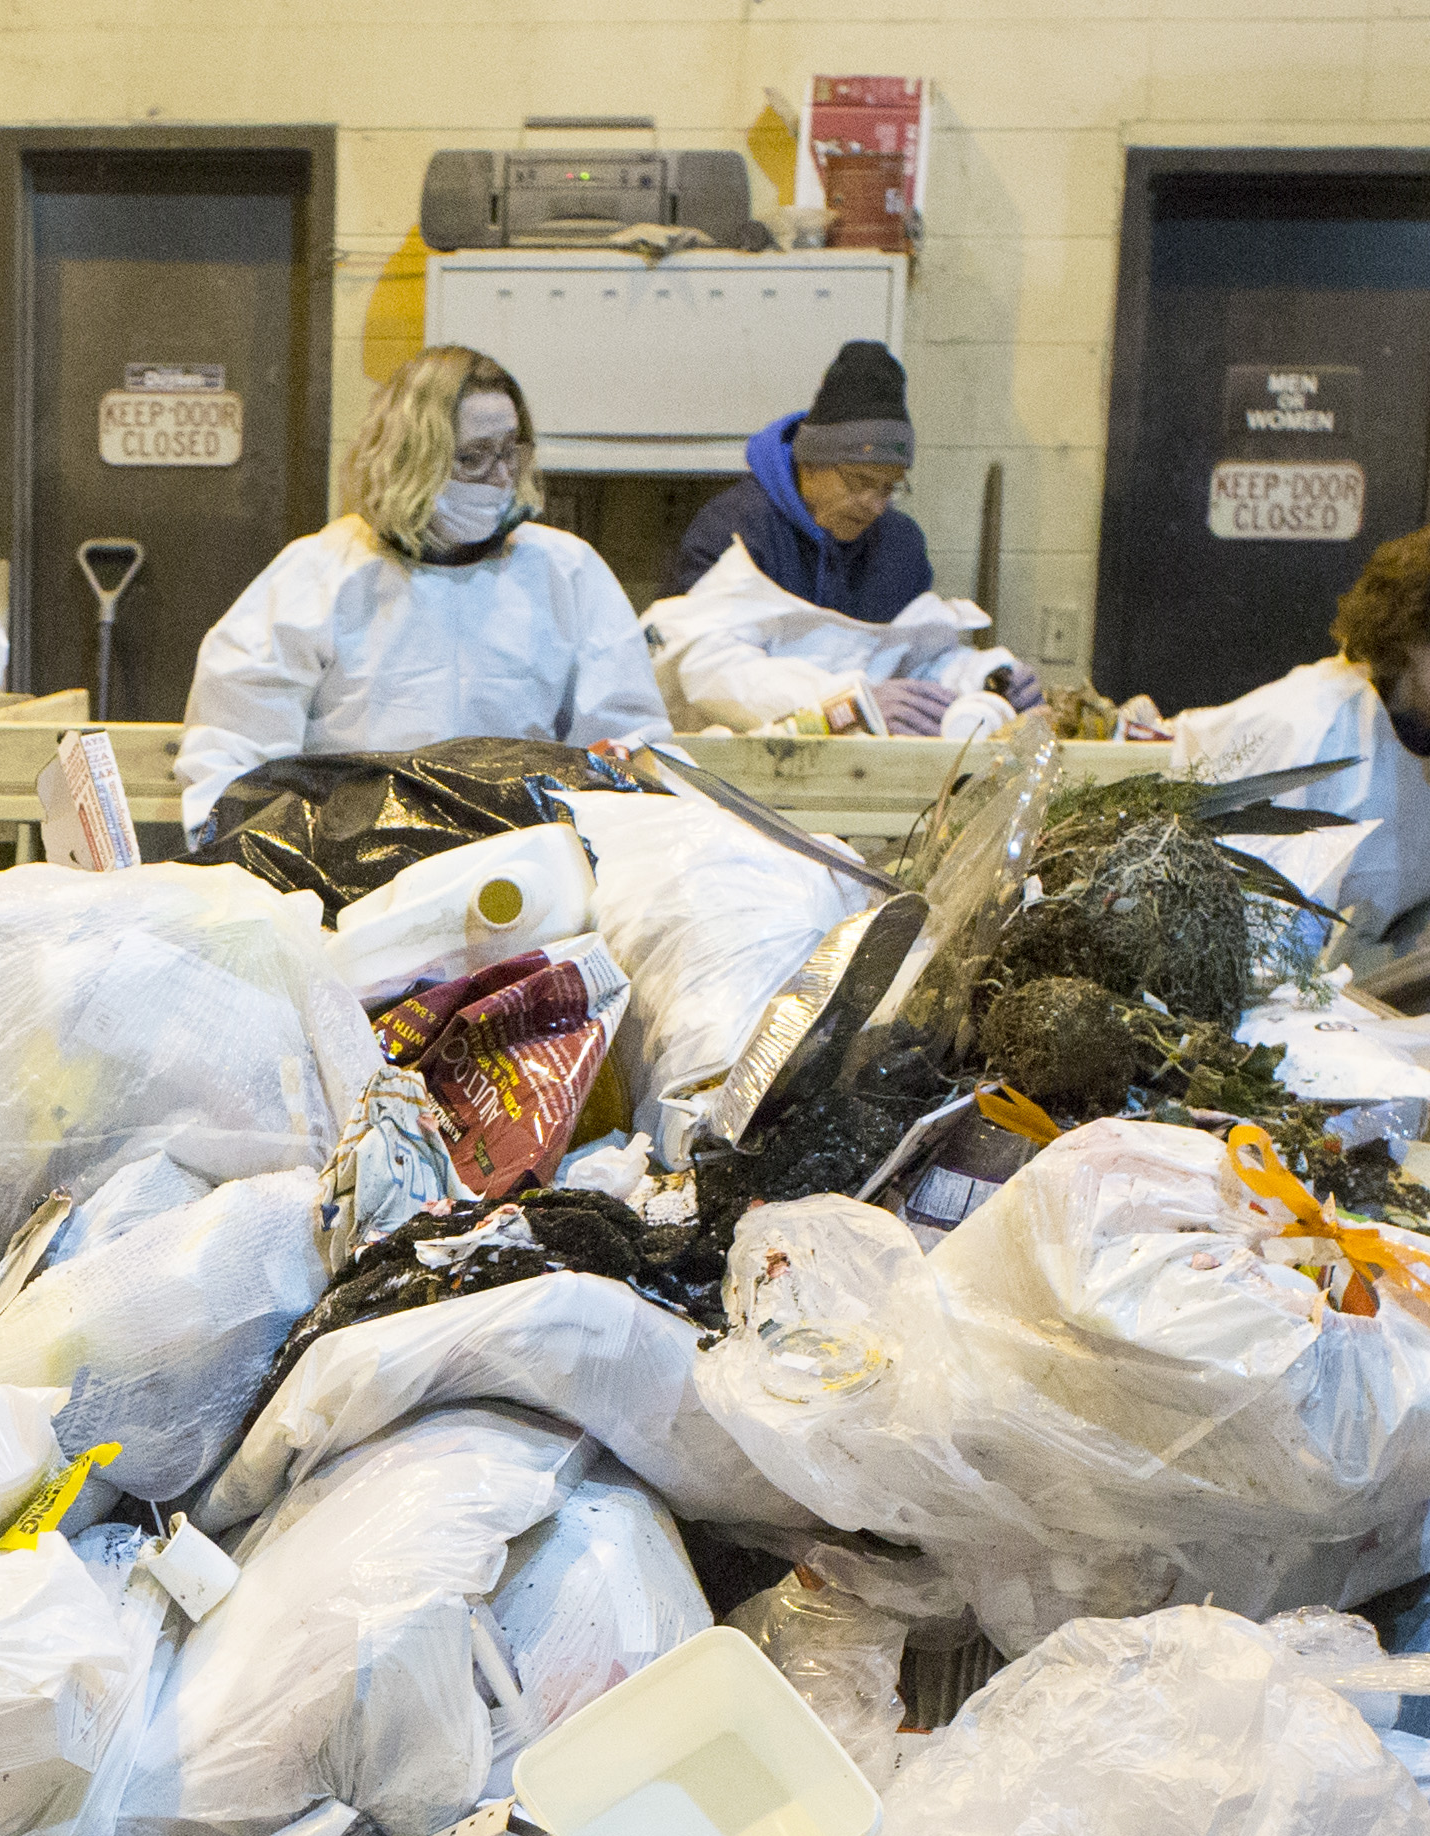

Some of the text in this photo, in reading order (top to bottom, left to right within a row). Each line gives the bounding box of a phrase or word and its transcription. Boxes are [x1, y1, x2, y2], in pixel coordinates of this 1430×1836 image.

[105, 401, 238, 428] KEEP DOOR
[1246, 410, 1334, 432] WOMEN
[121, 430, 220, 457] CLOSED
[1217, 472, 1359, 500] KEEP DOOR
[1233, 503, 1339, 531] CLOSED
[392, 1020, 427, 1046] WITH
[463, 1070, 503, 1129] AULT
